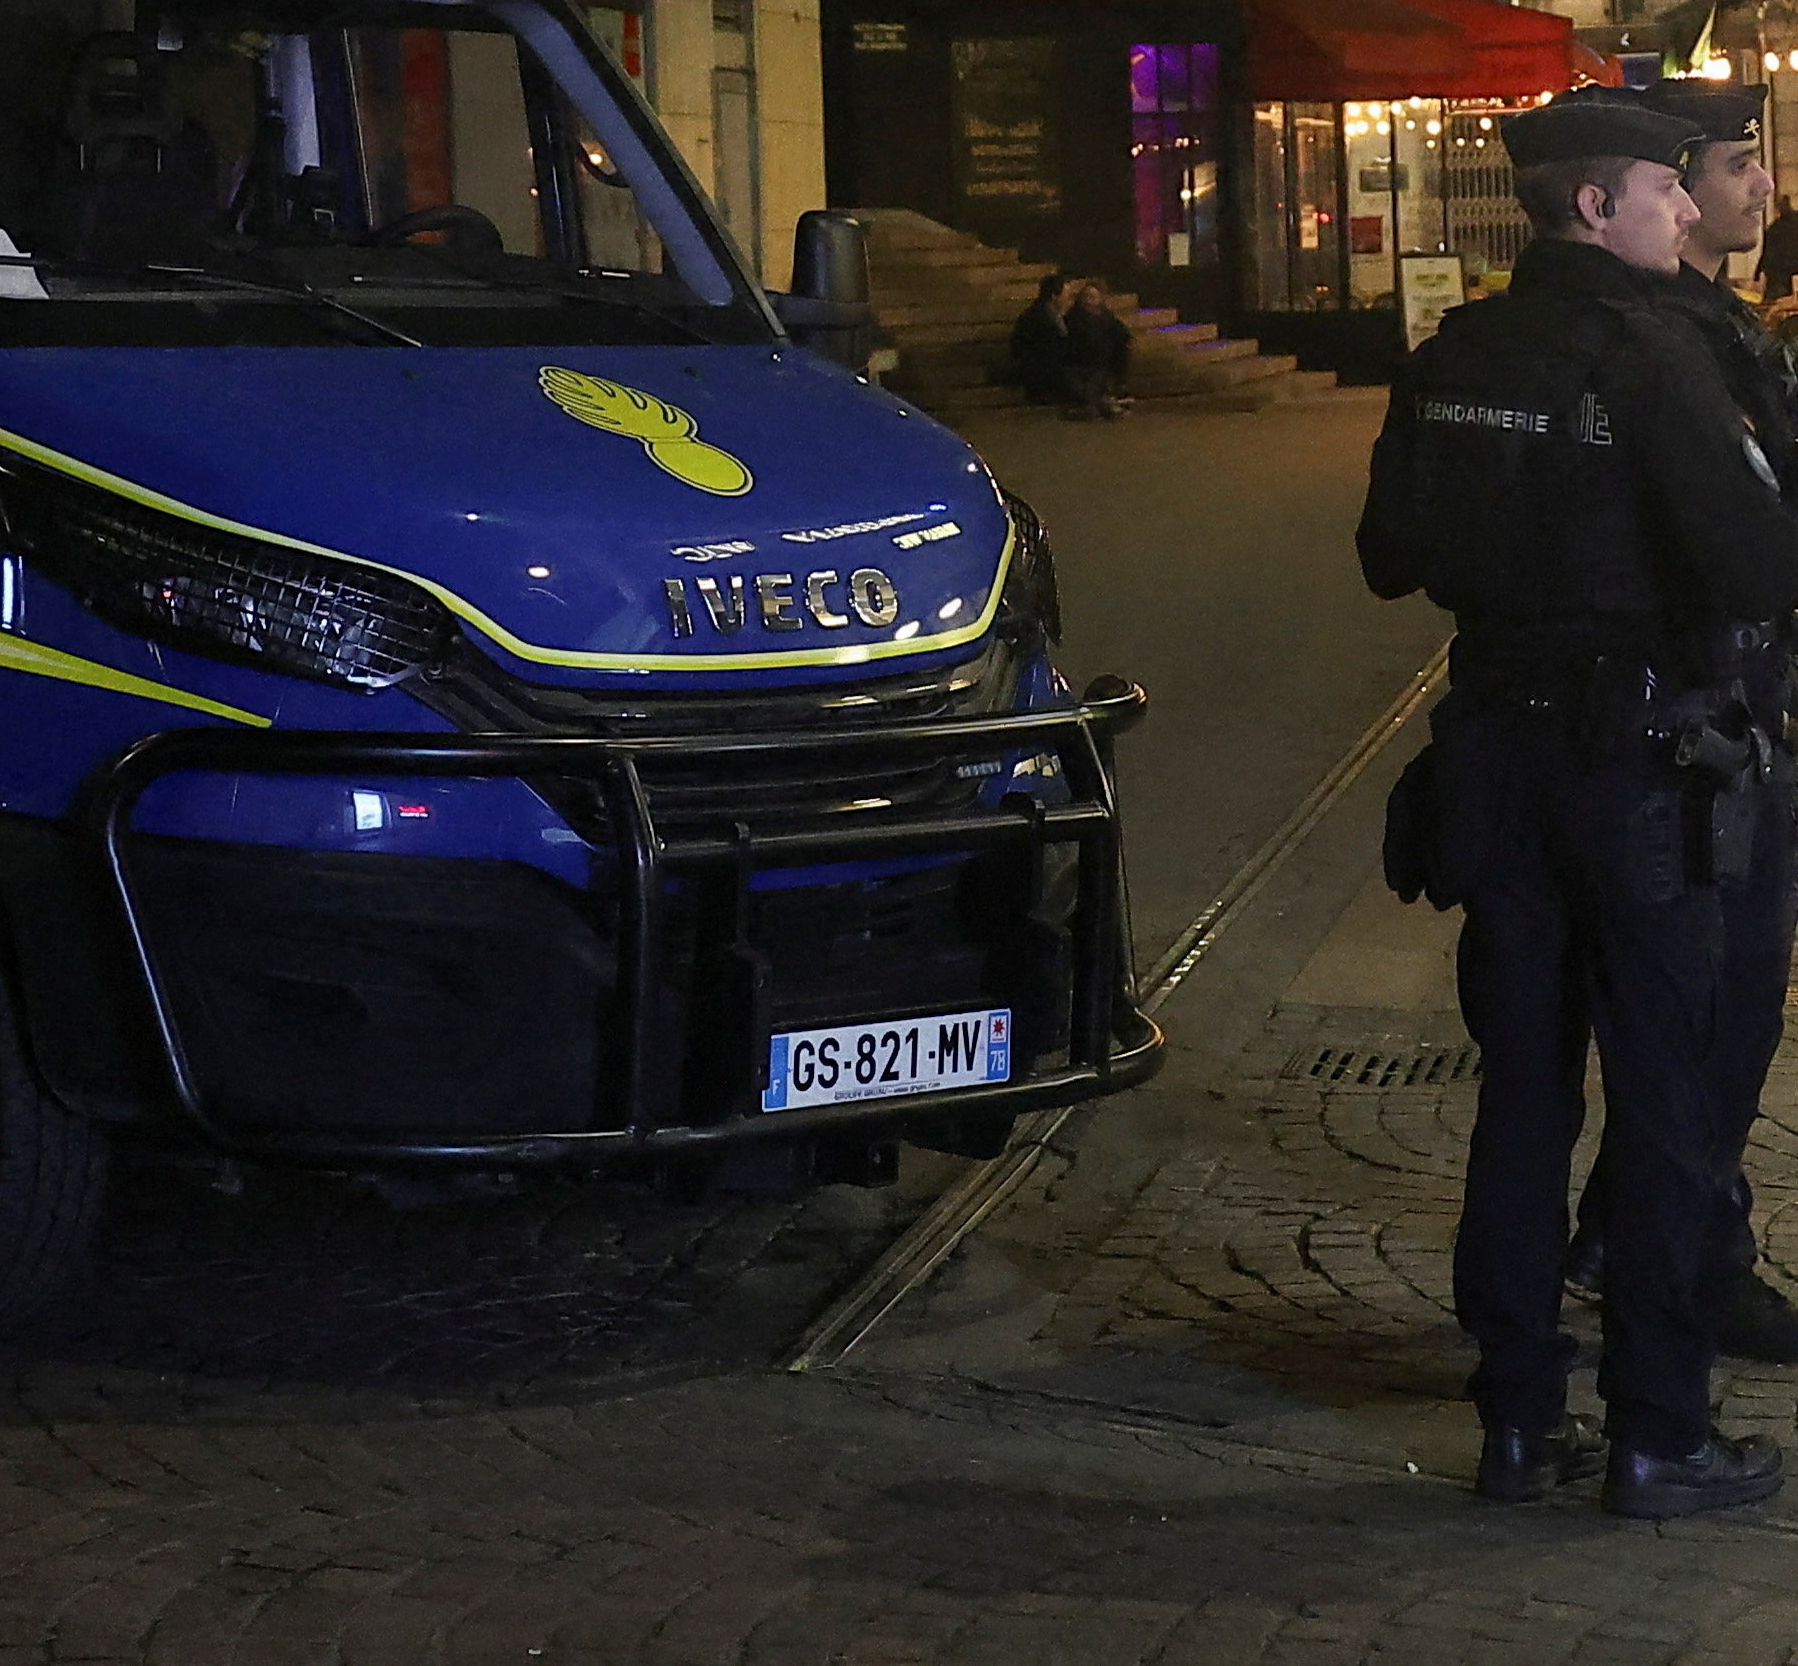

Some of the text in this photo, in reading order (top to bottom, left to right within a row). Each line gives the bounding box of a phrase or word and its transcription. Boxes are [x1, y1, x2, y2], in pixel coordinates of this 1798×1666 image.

[1424, 400, 1551, 434] GENDARMERIE
[663, 565, 899, 638] IVECO
[771, 1079, 781, 1097] F
[793, 1020, 982, 1092] GS-821-MV
[989, 1049, 1006, 1073] 78
